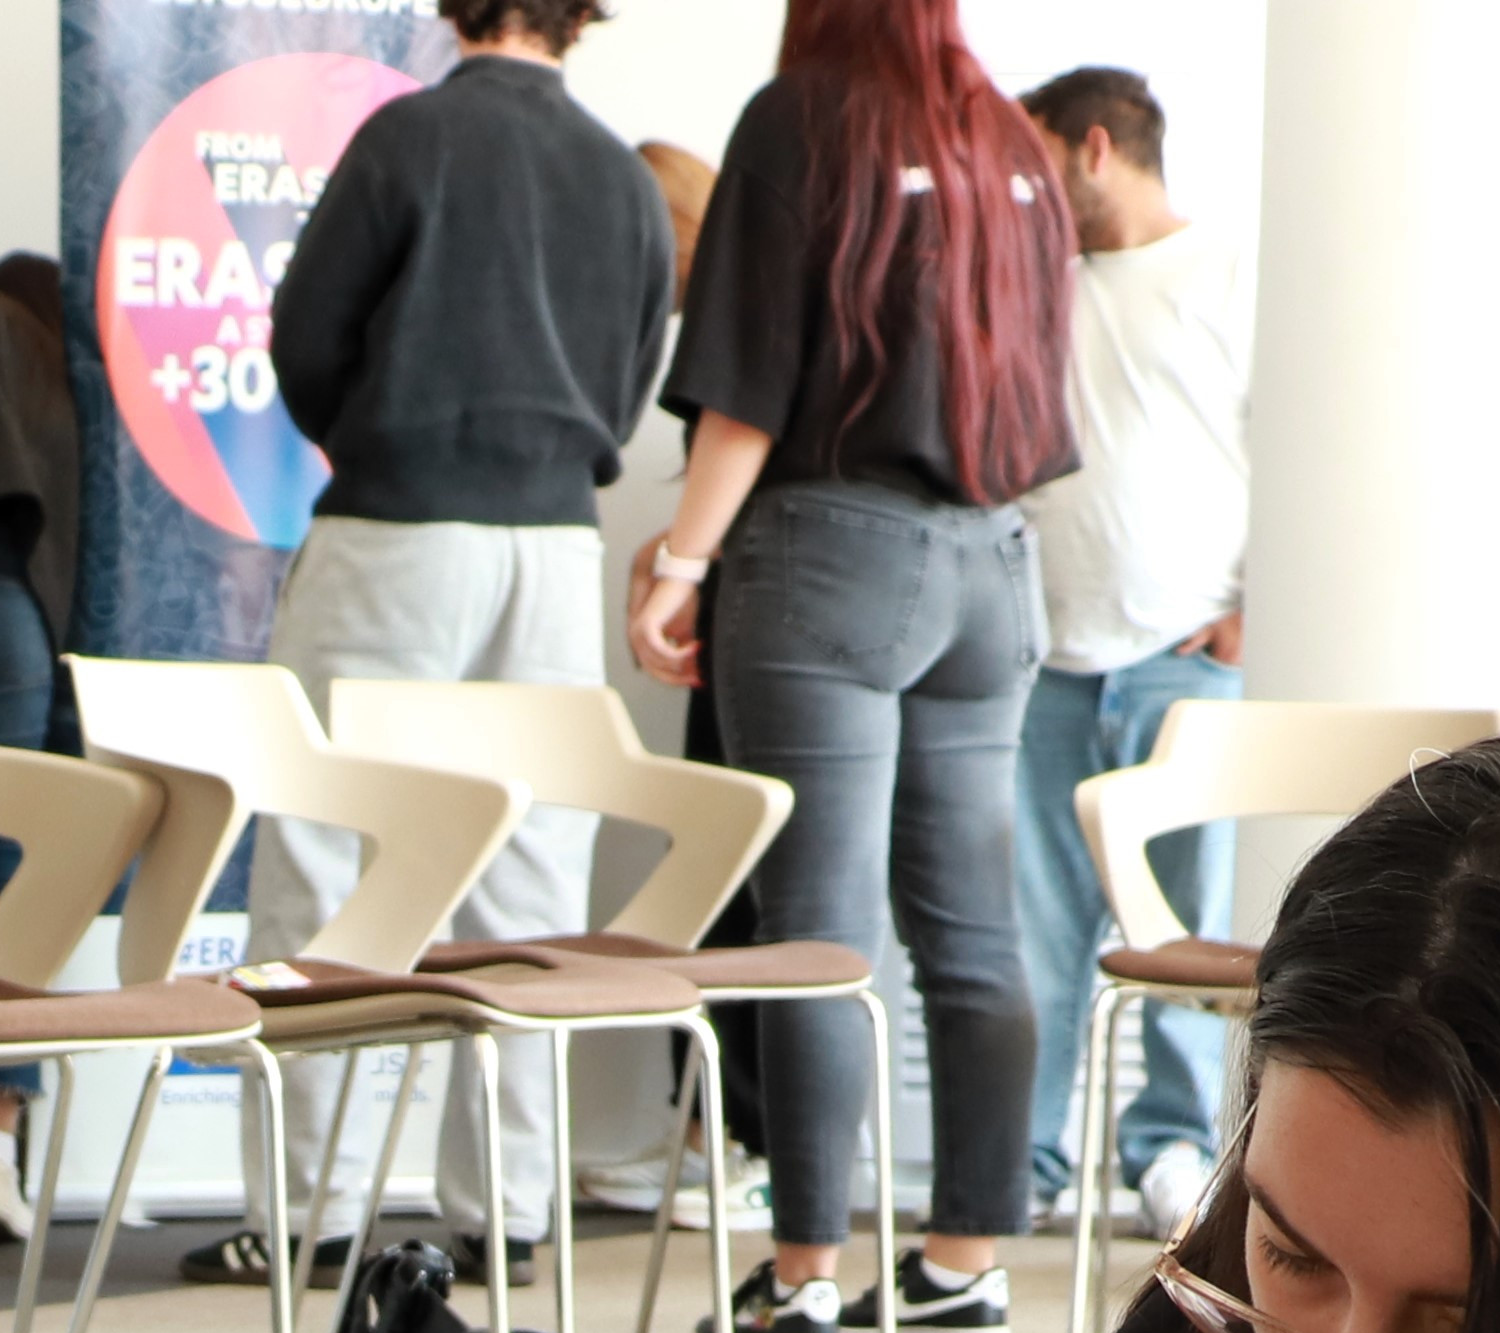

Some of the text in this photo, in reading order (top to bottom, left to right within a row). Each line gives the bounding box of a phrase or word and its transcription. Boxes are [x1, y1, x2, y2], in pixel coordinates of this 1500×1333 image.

[196, 131, 284, 161] FROM
[150, 345, 278, 414] +30
[178, 935, 246, 965] #ER
